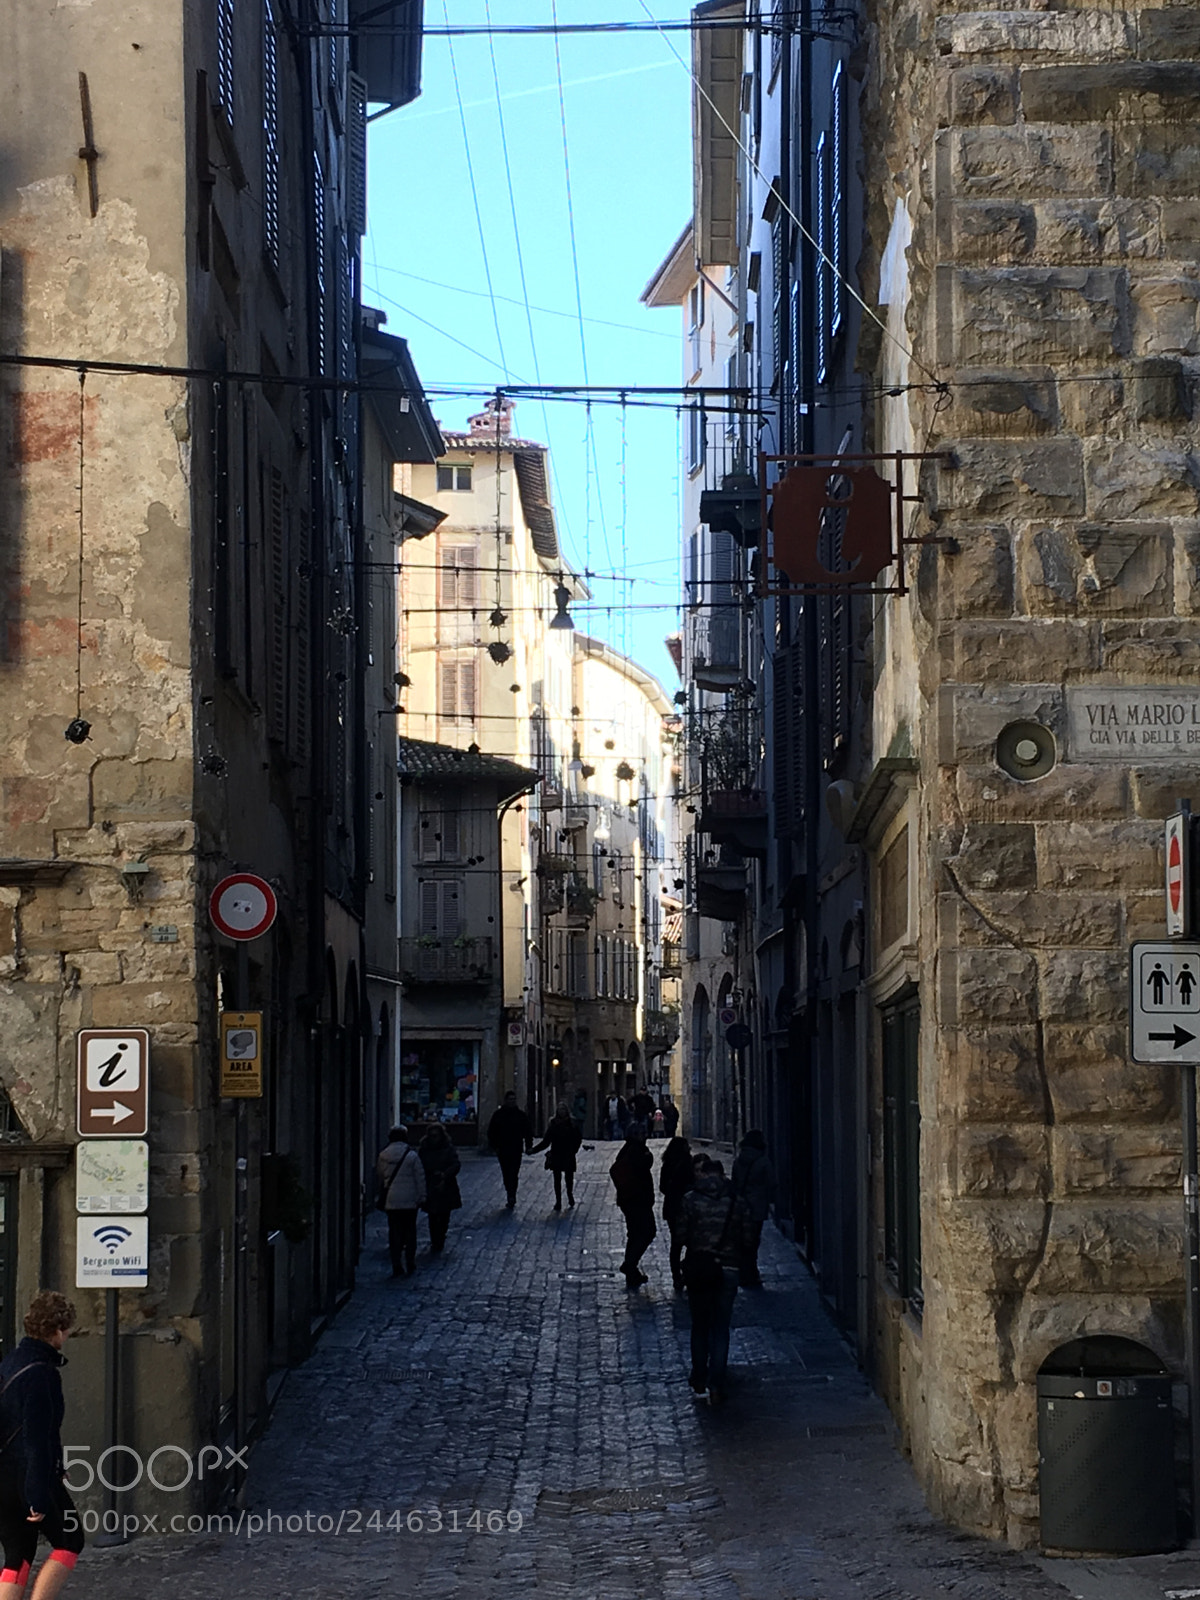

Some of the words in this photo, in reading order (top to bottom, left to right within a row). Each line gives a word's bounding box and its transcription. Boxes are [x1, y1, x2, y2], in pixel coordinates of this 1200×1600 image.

[1085, 704, 1120, 726] VIA
[1126, 704, 1185, 726] MARIO
[1115, 730, 1137, 744] VIA
[1142, 730, 1182, 744] DELLE
[229, 1062, 253, 1072] AREA
[83, 1257, 120, 1268] Bergamo
[122, 1256, 142, 1266] WiFi
